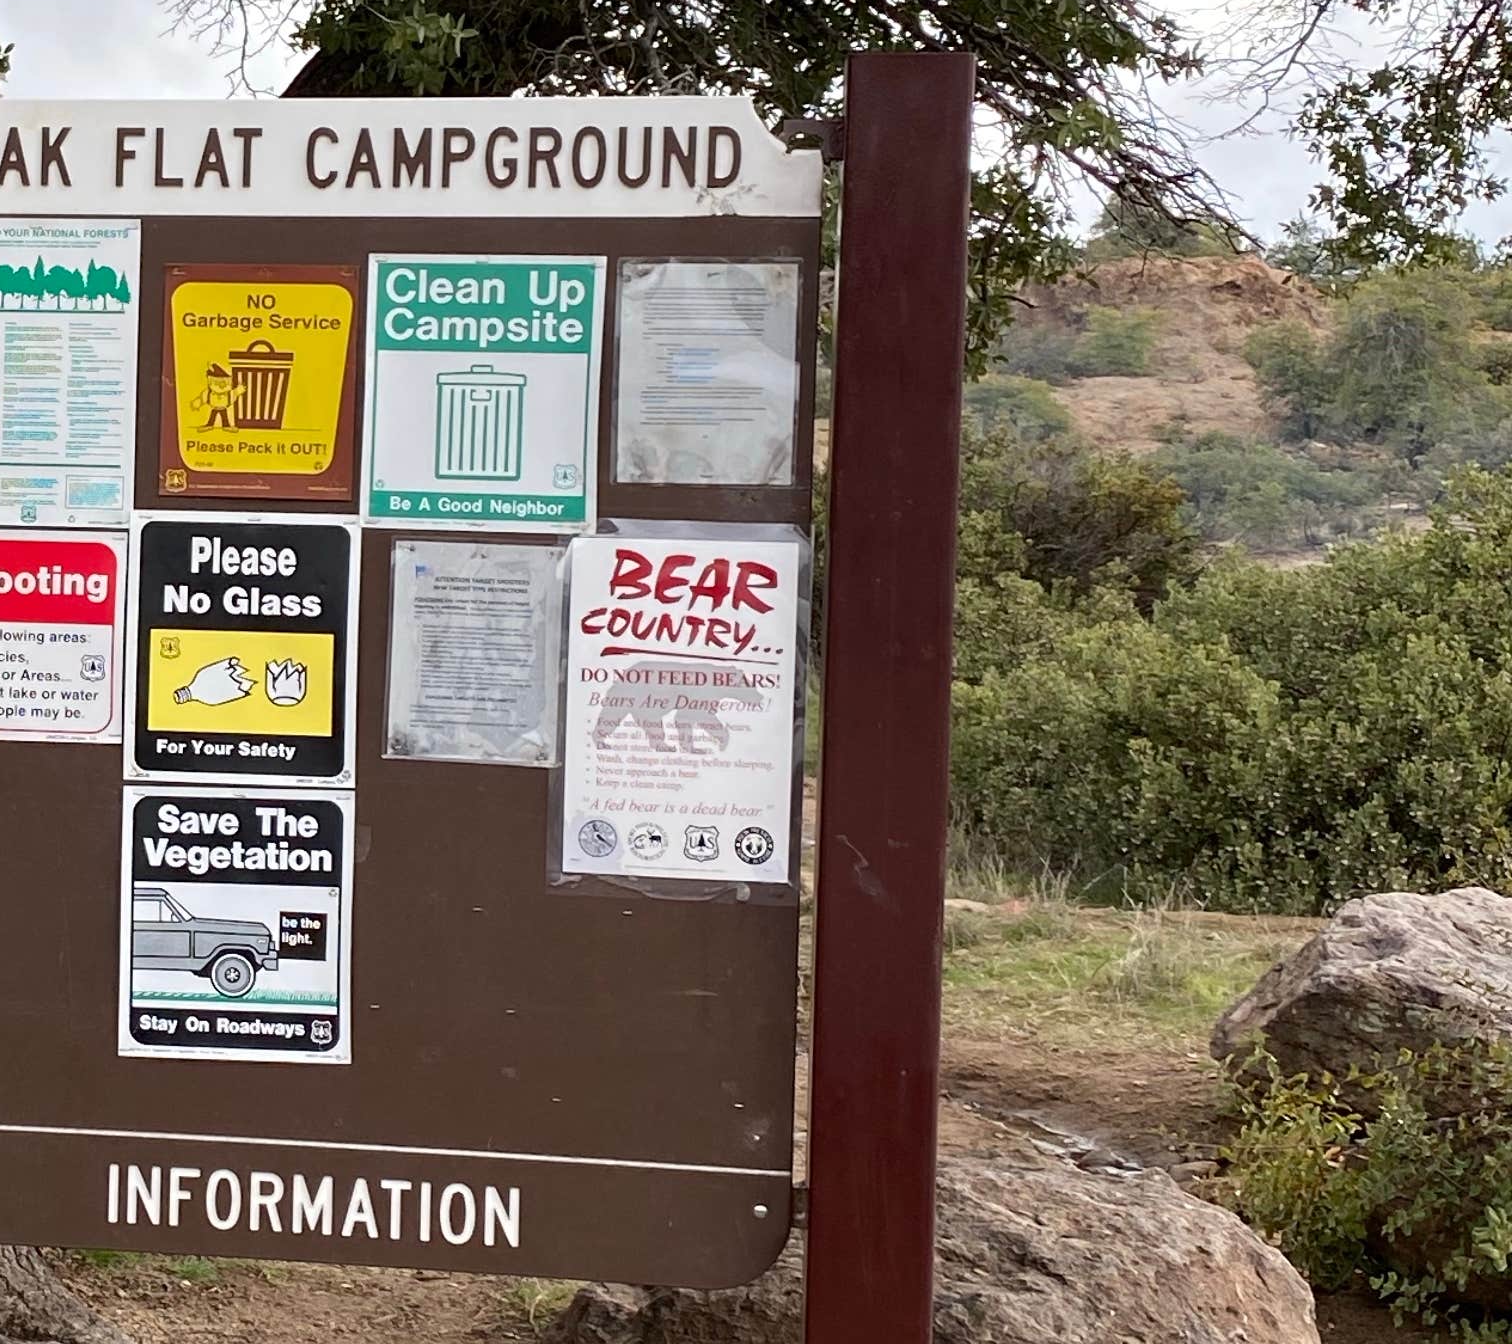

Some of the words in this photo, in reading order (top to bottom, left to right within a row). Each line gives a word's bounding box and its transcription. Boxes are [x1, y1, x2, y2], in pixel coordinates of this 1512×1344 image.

[115, 126, 263, 189] FLAT
[306, 125, 744, 190] CAMPGROUND
[3, 229, 30, 237] YOUR
[32, 229, 79, 238] NATIONAL
[83, 230, 129, 239] FORESTS
[385, 268, 506, 304] Clean
[529, 271, 585, 312] Up
[247, 294, 276, 309] NO
[183, 313, 263, 331] Garbage
[269, 314, 341, 330] Service
[384, 307, 584, 348] Campsite
[186, 441, 233, 453] Please
[239, 442, 272, 454] Pack
[290, 443, 327, 455] OUT!
[390, 496, 411, 510] Be
[419, 497, 431, 511] A
[438, 497, 483, 513] Good
[490, 500, 564, 517] Neighbor
[191, 536, 297, 577] Please
[609, 548, 778, 614] BEAR
[163, 585, 211, 614] No
[223, 586, 322, 617] Glass
[581, 608, 784, 655] COUNTRY...
[1, 670, 16, 680] or
[581, 668, 608, 683] DO
[613, 668, 655, 684] NOT
[658, 670, 708, 686] FEED
[713, 671, 781, 689] BEARS!
[9, 687, 37, 699] lake
[41, 690, 56, 700] or
[60, 690, 98, 701] water
[588, 692, 635, 708] Bears
[641, 695, 669, 710] Are
[674, 695, 772, 714] Dangerous!
[31, 707, 59, 720] may
[156, 739, 187, 754] For
[191, 740, 234, 756] Your
[238, 742, 296, 761] Safety
[596, 765, 623, 775] Never
[602, 798, 626, 813] fed
[629, 799, 660, 813] bear
[663, 801, 675, 814] is
[678, 804, 688, 815] a
[691, 802, 727, 816] dead
[158, 804, 239, 835] Save
[255, 807, 319, 838] The
[143, 838, 332, 875] Vegetation
[282, 916, 297, 928] be
[300, 917, 321, 930] the
[282, 932, 313, 946] light.
[139, 1014, 178, 1033] Stay
[185, 1016, 210, 1032] On
[216, 1018, 305, 1037] Roadways
[107, 1162, 521, 1249] INFORMATION
